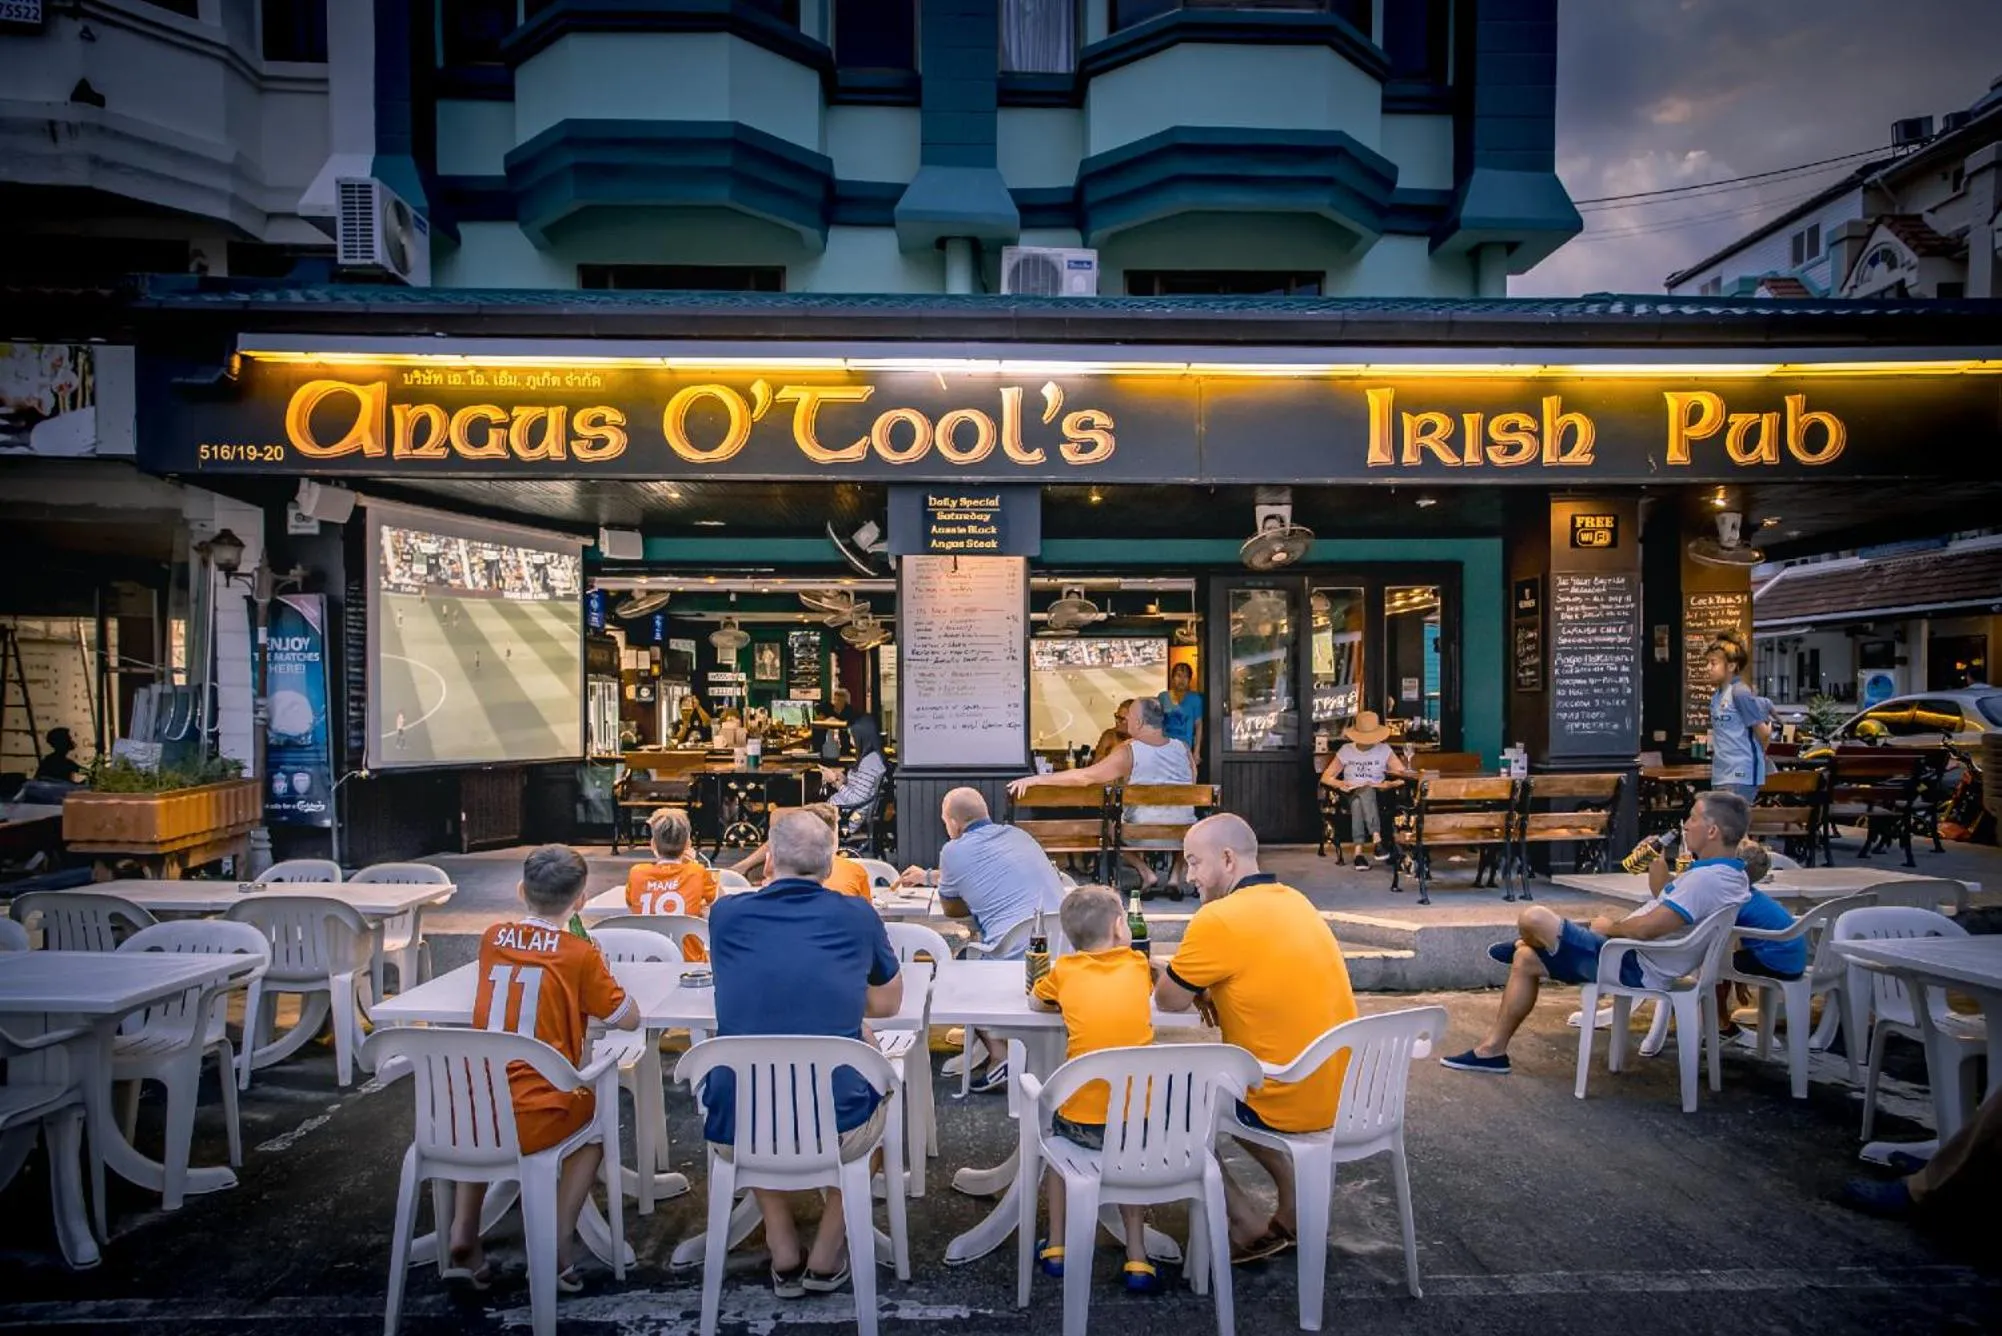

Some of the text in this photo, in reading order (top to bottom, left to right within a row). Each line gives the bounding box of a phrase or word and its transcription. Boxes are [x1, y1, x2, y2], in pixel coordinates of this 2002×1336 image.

[403, 370, 443, 386] บริษัท
[285, 378, 1847, 467] Angus O'Tool's Irish Pub
[199, 444, 284, 462] 516/19-20
[928, 494, 1000, 508] Daily Special
[937, 511, 991, 522] Saturday
[1575, 516, 1614, 528] FREE
[967, 525, 997, 534] Black
[931, 539, 998, 550] Angus Steak
[253, 652, 320, 662] TE MATCHES
[646, 880, 680, 891] MANE
[493, 926, 560, 952] SALAH
[486, 964, 544, 1039] 11
